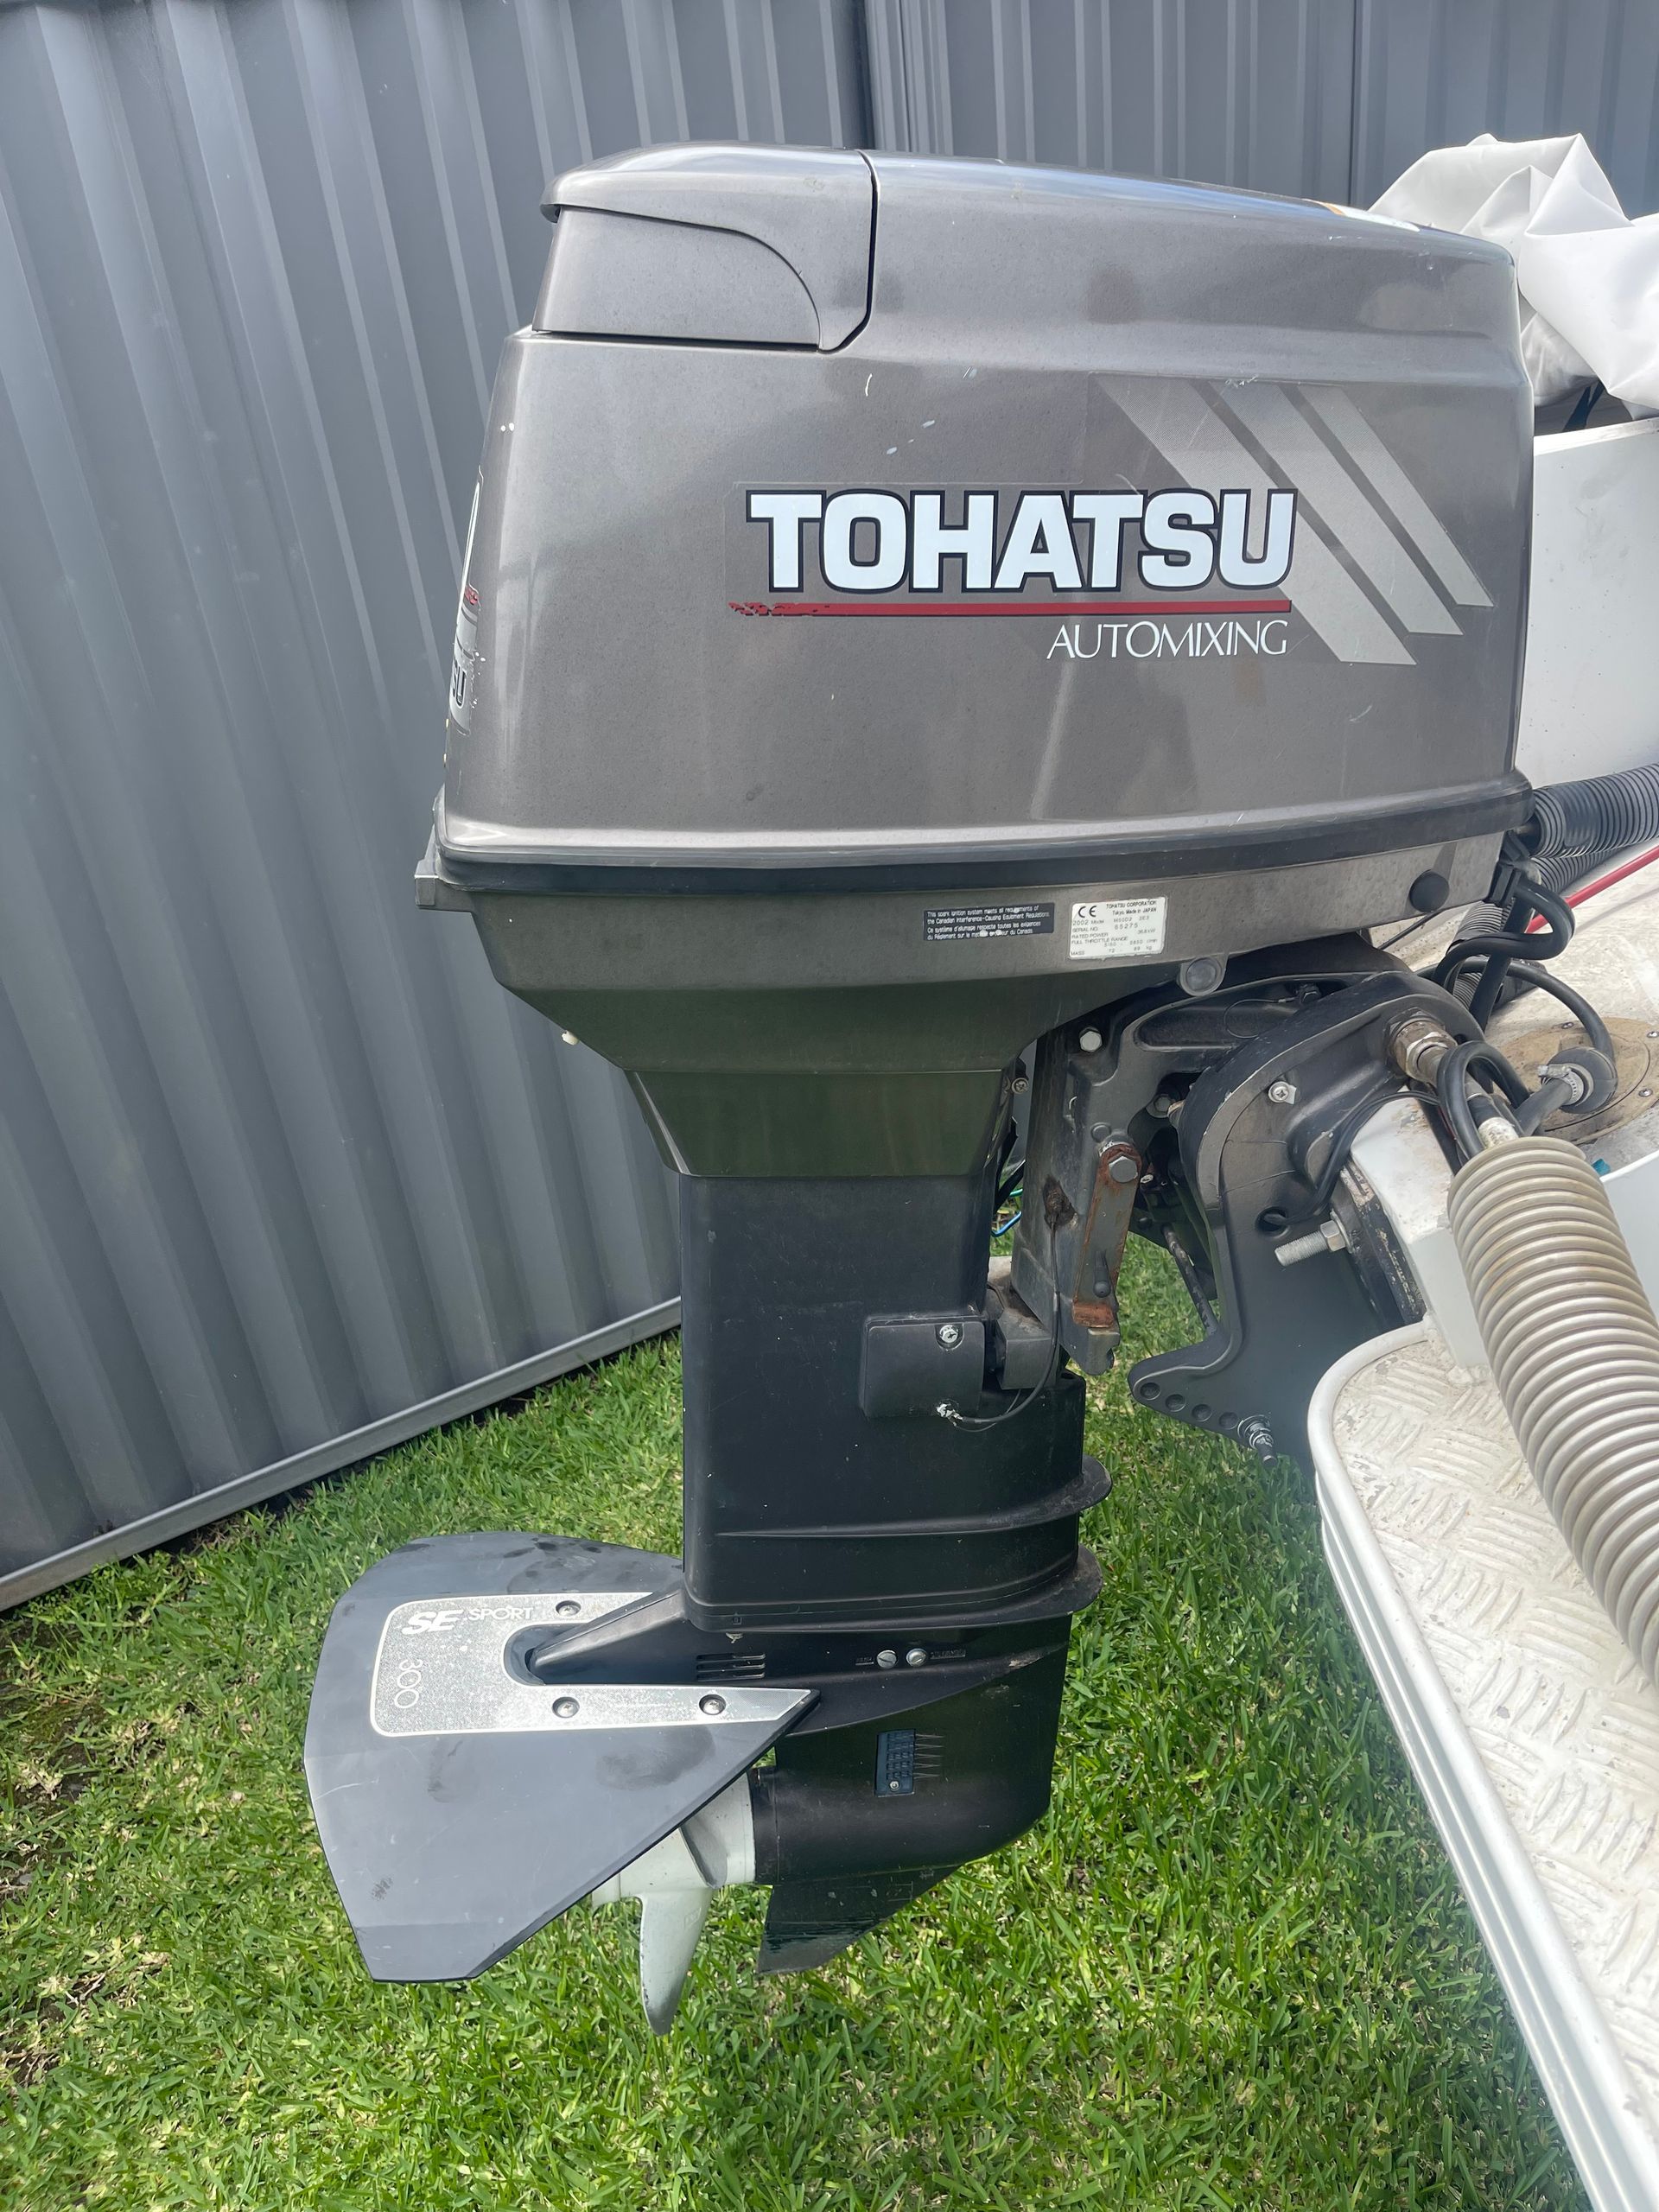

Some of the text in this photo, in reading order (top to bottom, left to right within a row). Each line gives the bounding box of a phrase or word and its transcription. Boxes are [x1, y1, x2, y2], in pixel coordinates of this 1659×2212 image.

[746, 488, 1298, 594] TOHATSU
[1046, 620, 1288, 659] AUTOMIXING
[402, 1610, 463, 1635] SE
[394, 1659, 423, 1709] 300
